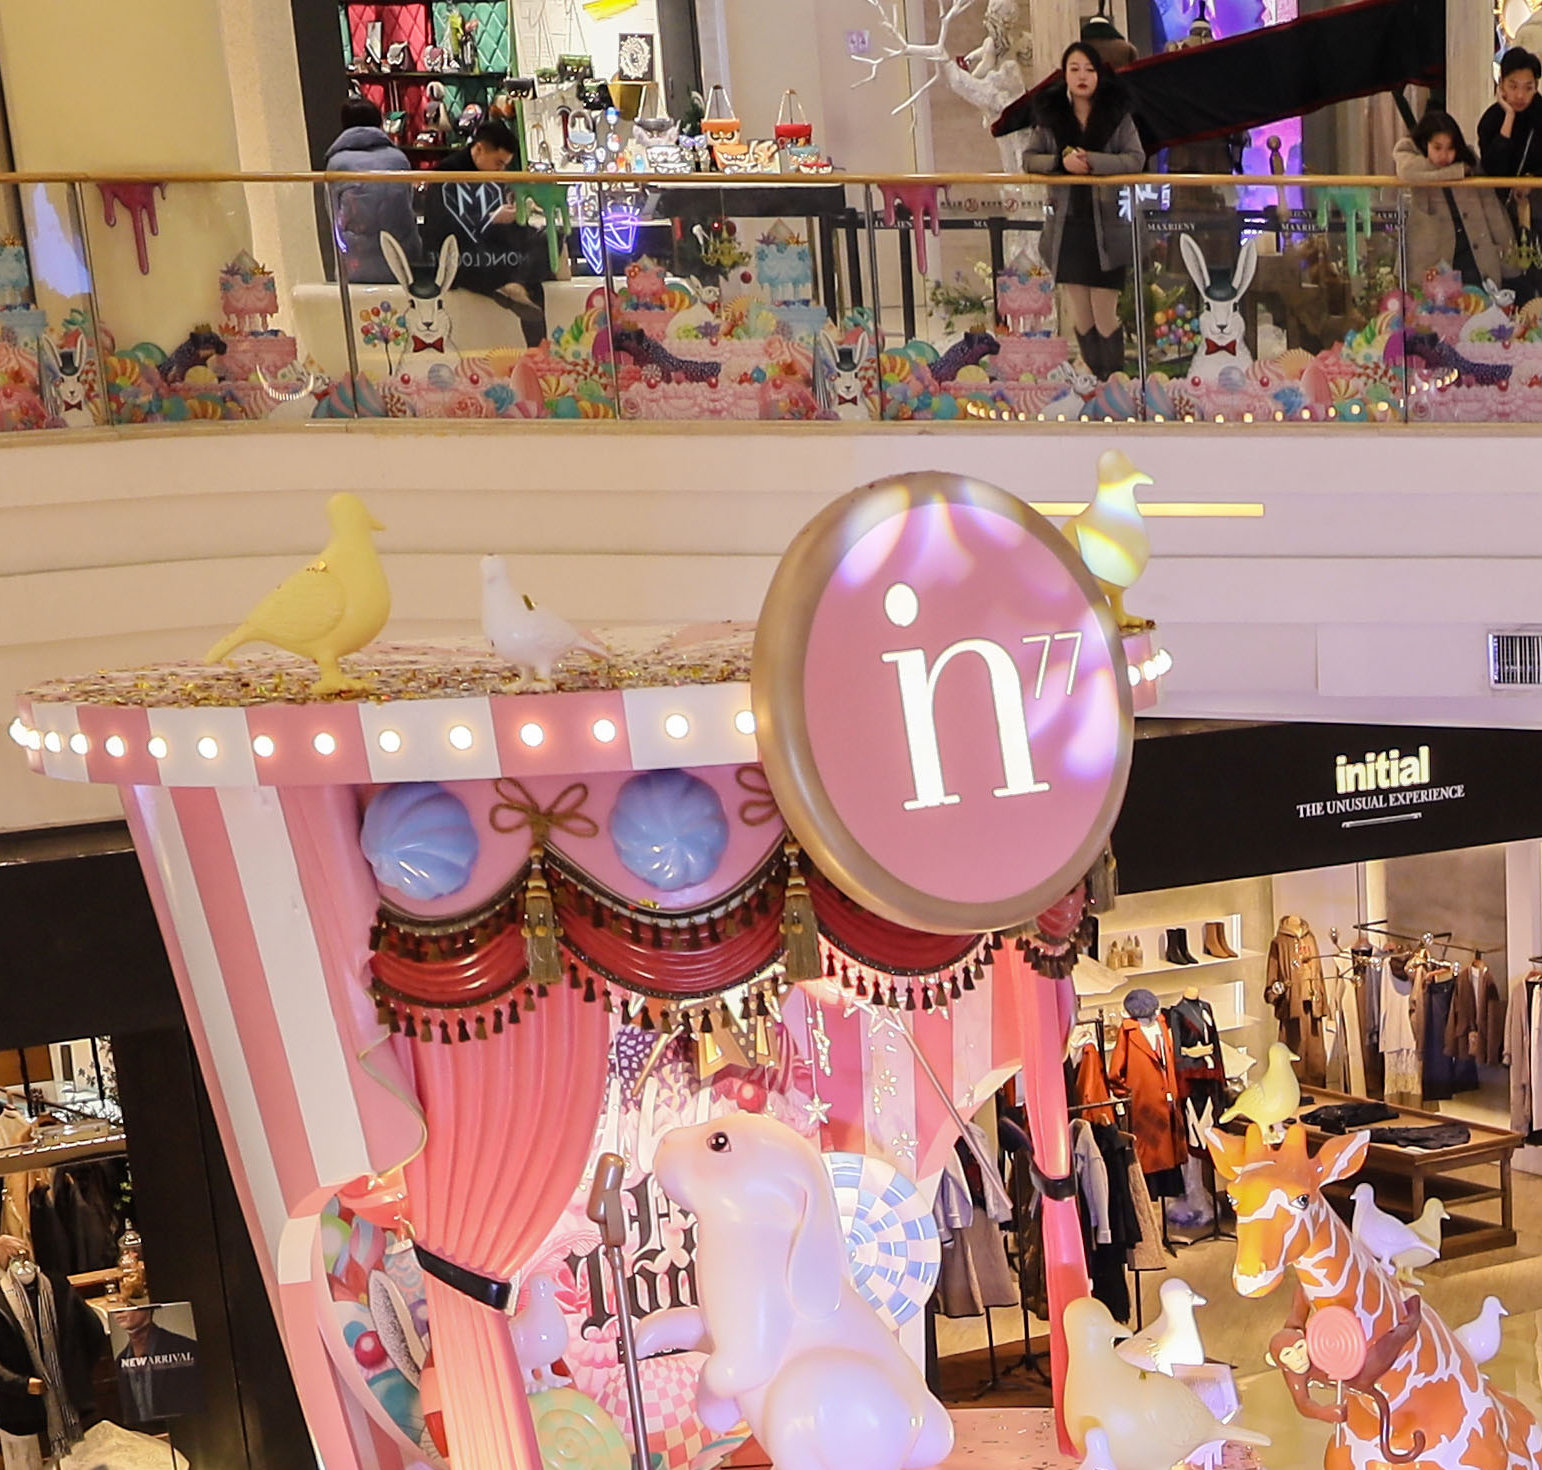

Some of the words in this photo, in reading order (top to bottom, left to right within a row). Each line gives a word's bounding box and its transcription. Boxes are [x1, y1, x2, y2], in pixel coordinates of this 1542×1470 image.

[1335, 745, 1431, 795] initial
[1296, 800, 1325, 818] THE
[1326, 794, 1388, 815] UNUSUAL
[1388, 784, 1466, 807] EXPERIENCE
[121, 1356, 147, 1369] NEW
[147, 1351, 192, 1365] ARRIVAL
